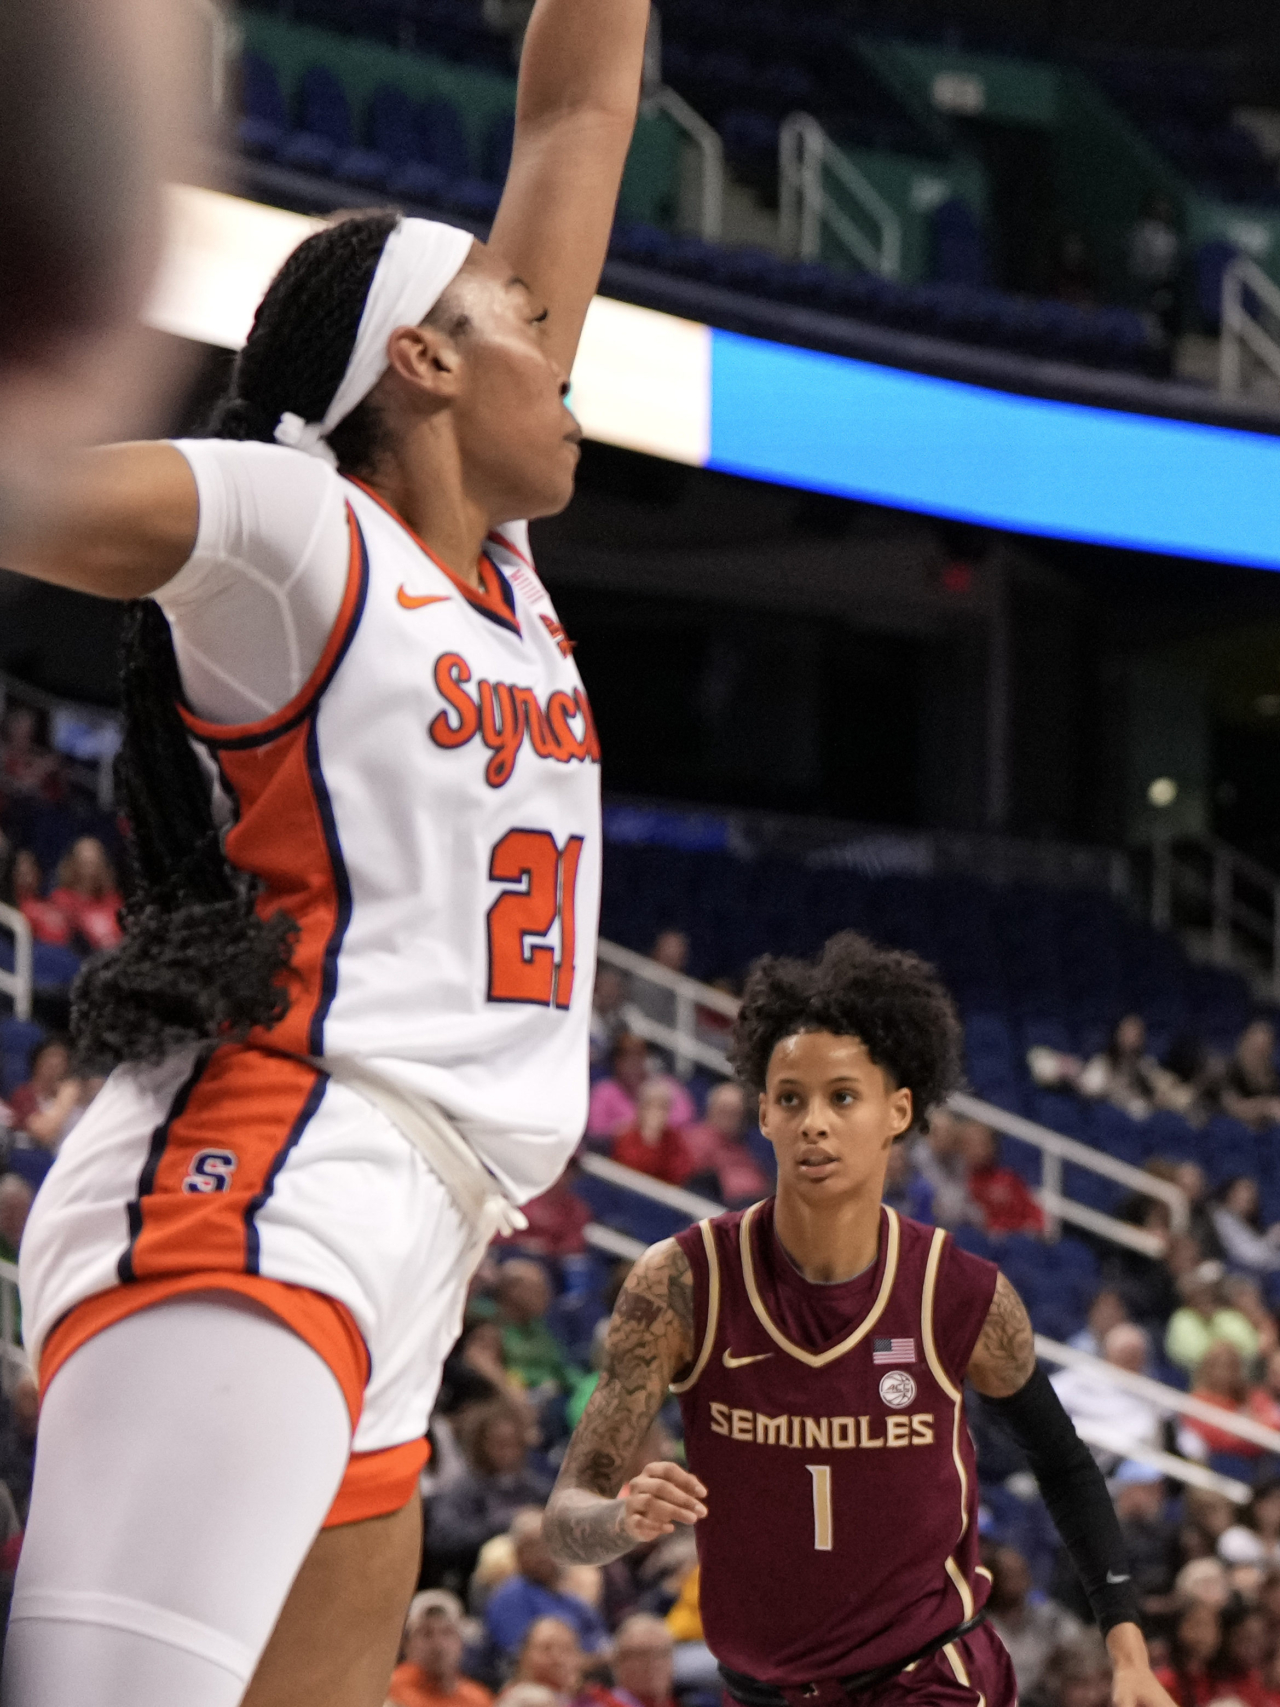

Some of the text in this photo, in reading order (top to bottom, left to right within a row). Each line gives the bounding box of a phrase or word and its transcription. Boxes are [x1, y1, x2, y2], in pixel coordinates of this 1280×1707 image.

[486, 826, 585, 1010] 21
[181, 1148, 239, 1196] S
[709, 1401, 934, 1448] SEMINOLES
[805, 1465, 832, 1551] 1
